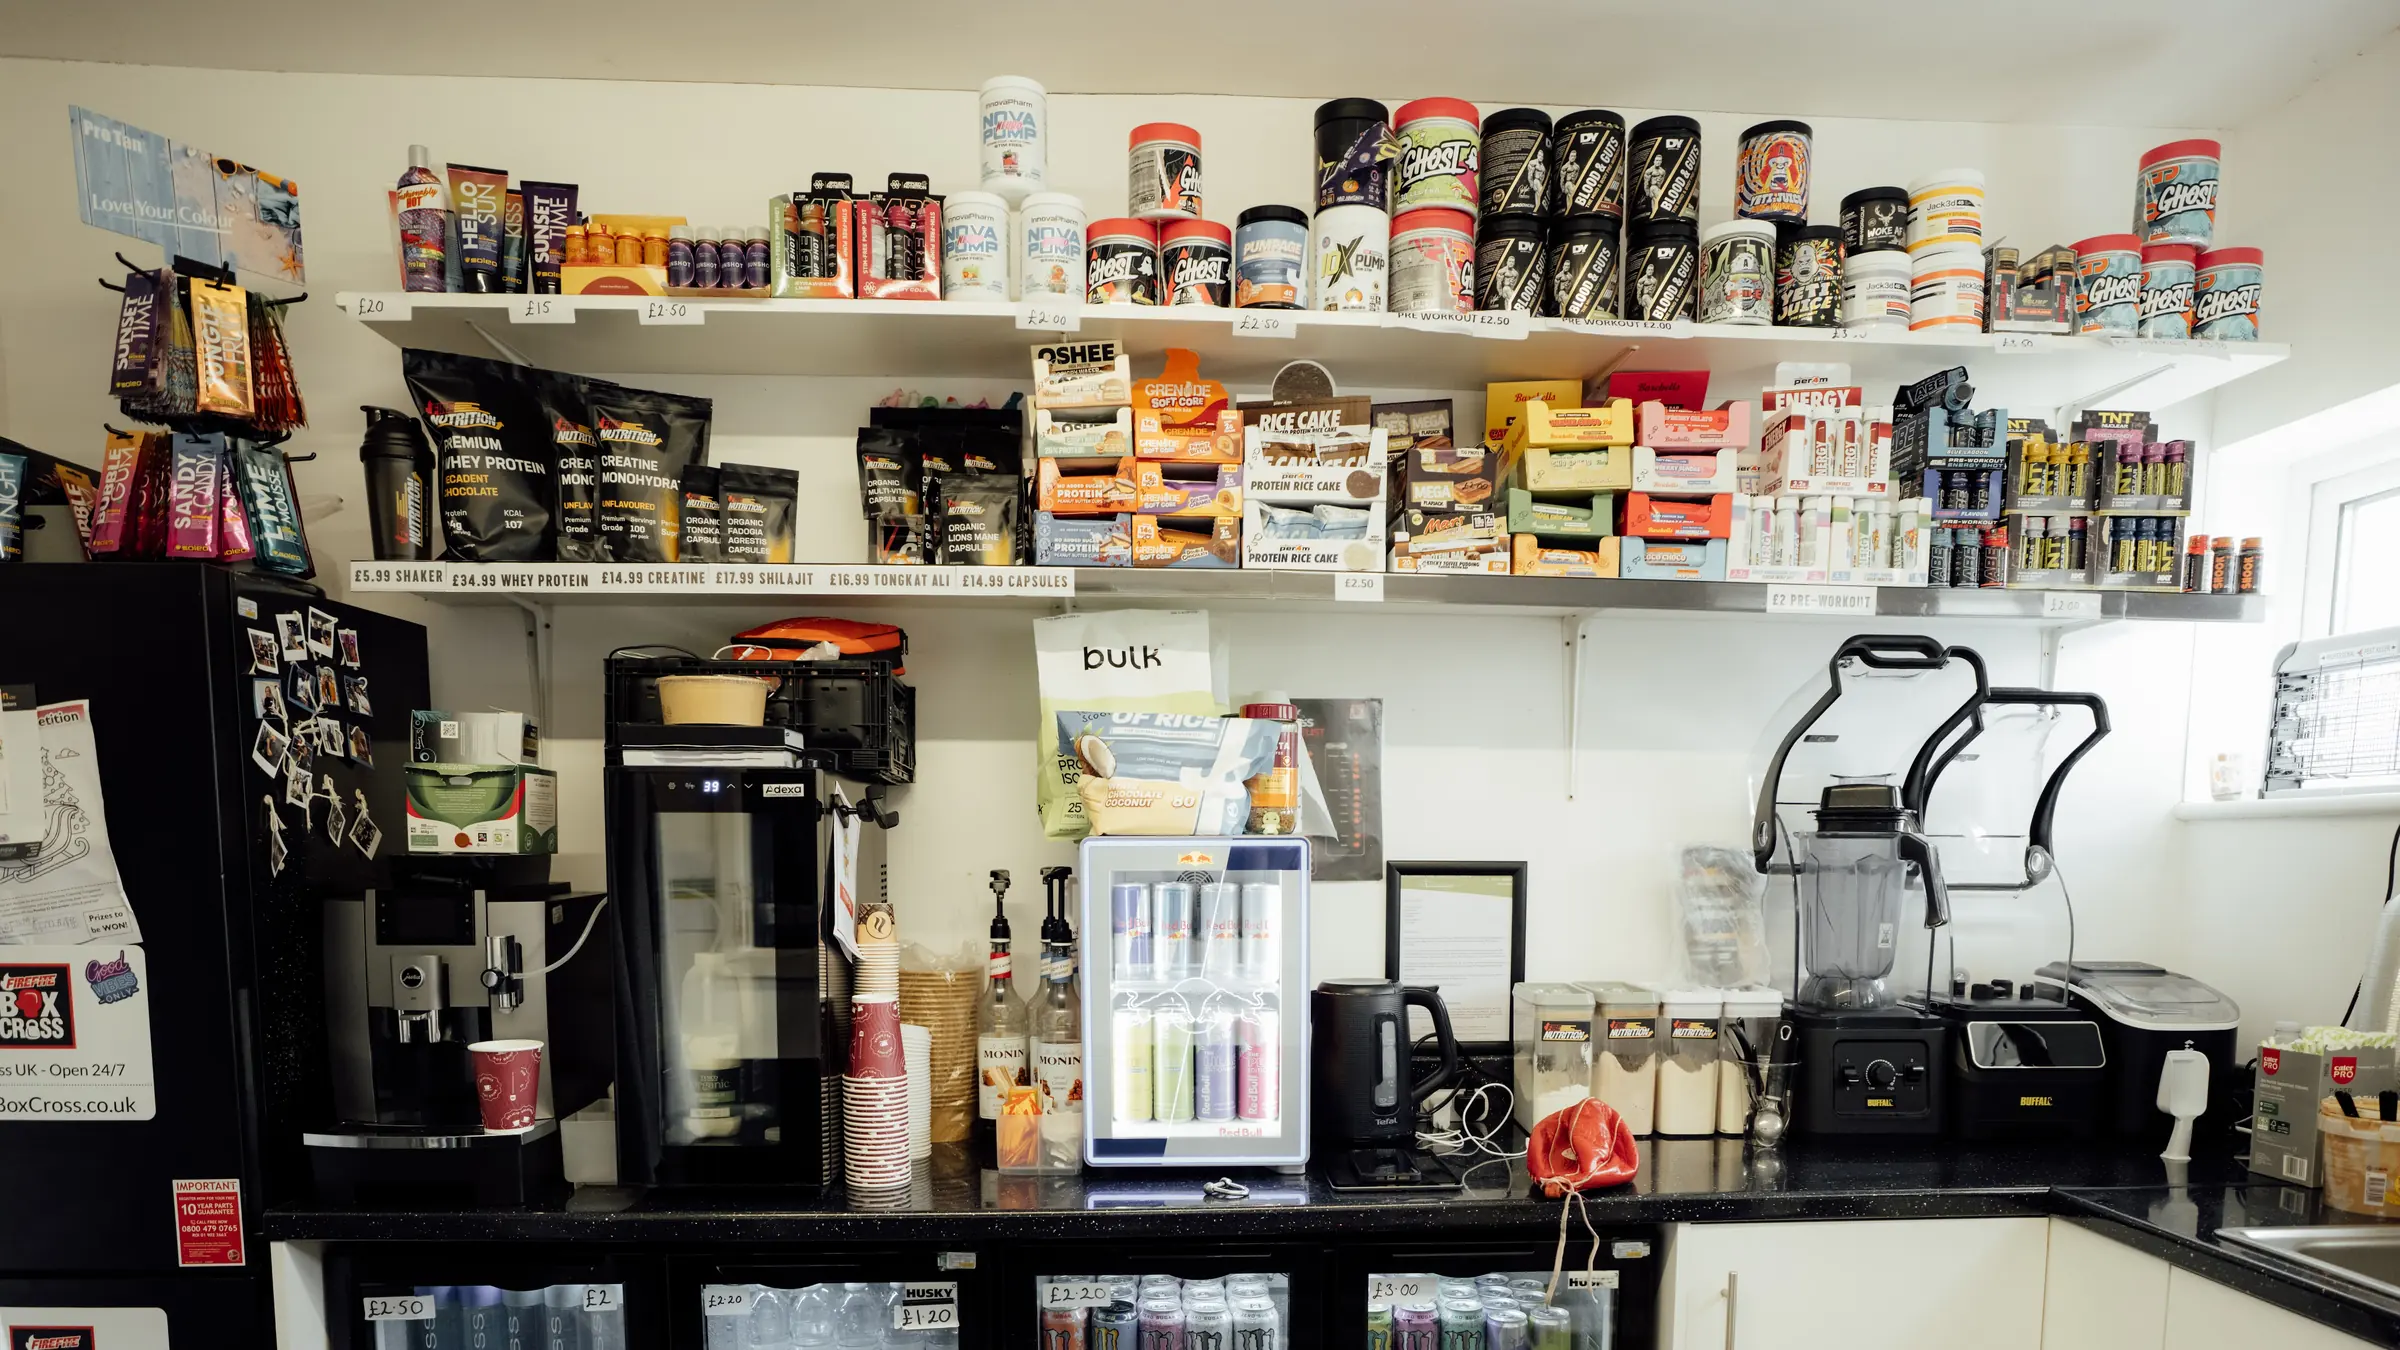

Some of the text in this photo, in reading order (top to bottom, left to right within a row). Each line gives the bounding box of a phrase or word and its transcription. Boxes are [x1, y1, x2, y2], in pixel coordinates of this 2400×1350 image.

[983, 111, 1035, 129] NOVA
[83, 119, 143, 153] Pro Tan
[983, 128, 1037, 144] PUMP
[1402, 139, 1471, 188] GHOST
[406, 197, 421, 208] HOT
[477, 184, 498, 226] SUN
[1926, 200, 1956, 211] Jack3d
[2156, 180, 2217, 220] GHOST
[92, 193, 235, 229] Love Your Colour
[461, 181, 479, 250] HELLO
[549, 197, 568, 238] TIME
[947, 213, 994, 223] InnovaPharm
[505, 202, 524, 238] KISS
[533, 195, 551, 264] SUNSET
[945, 225, 998, 242] NOVA
[1028, 227, 1081, 243] NOVA
[1867, 226, 1892, 238] WOKE
[945, 241, 998, 257] PUMP
[1028, 242, 1081, 257] PUMP
[1243, 238, 1302, 255] PUMPAGE
[1518, 241, 1535, 251] DY
[1572, 244, 1589, 254] DY
[1657, 248, 1676, 258] DY
[1355, 254, 1385, 269] PUMP
[1174, 257, 1228, 292] GHOST
[1568, 247, 1612, 315] BLOOD & GUTS
[1652, 251, 1695, 320] BLOOD & GUTS
[1782, 282, 1829, 303] YETI
[1866, 282, 1893, 290] Jack3d
[359, 299, 384, 315] £20
[526, 300, 551, 316] £15
[1777, 294, 1832, 321] JUICE
[2195, 284, 2262, 328] GHOST
[131, 293, 154, 341] TIME
[1421, 313, 1477, 324] WORKOUT
[1480, 315, 1510, 326] £2.50
[1584, 318, 1641, 329] WORKOUT
[1643, 321, 1672, 331] £2.00
[117, 296, 138, 371] SUNSET
[1037, 343, 1115, 365] OSHEE
[1794, 377, 1828, 386] per4m
[1151, 397, 1204, 408] SOFT CORE
[1776, 389, 1850, 408] ENERGY
[1260, 410, 1341, 431] RICE CAKE
[1413, 415, 1446, 429] MEGA
[2099, 413, 2134, 424] TNT
[444, 435, 503, 452] PREMIUM
[600, 430, 656, 443] NUTRITION
[485, 456, 546, 475] PROTEIN
[601, 455, 659, 471] CREATINE
[111, 447, 136, 502] GUM
[193, 453, 217, 508] CANDY
[867, 479, 900, 487] ORGANIC
[1250, 481, 1341, 491] PROTEIN RICE CAKE
[174, 454, 197, 530] SANDY
[275, 469, 292, 525] MOUSSE
[868, 488, 917, 496] MULTI-VITAMIN
[1414, 485, 1451, 499] MEGA
[249, 464, 284, 542] LIME
[602, 500, 656, 511] UNFLAVOURED
[504, 509, 524, 518] KCAL
[504, 521, 522, 529] 107
[601, 524, 623, 532] Grade
[630, 516, 656, 526] Servings
[727, 518, 763, 527] ORGANIC
[948, 523, 986, 532] ORGANIC
[1424, 516, 1465, 535] Mars
[566, 525, 588, 533] Grade
[630, 525, 646, 533] 100
[728, 527, 763, 536] FADOGIA
[728, 536, 767, 545] AGRESTIS
[948, 533, 999, 542] LIONS MANE
[728, 546, 770, 555] CAPSULES
[1248, 553, 1338, 563] PROTEIN RICE CAKE
[355, 569, 443, 583] £5.99 SHAKER
[452, 574, 589, 587] £34.99 WHEY PROTEIN
[602, 571, 706, 585] £14.99 CREATINE
[716, 572, 814, 586] £17.99 SHILAJIT
[830, 573, 949, 587] £16.99 TONGKAT ALI
[962, 574, 1068, 588] £14.99 CAPSULES
[1345, 578, 1374, 589] £2.50
[1773, 594, 1871, 608] £2 PRE-WORKOUT
[1084, 645, 1162, 670] bulk
[703, 781, 720, 793] 39
[765, 785, 803, 795] Adexa
[1107, 790, 1163, 799] CHOCOLATE
[1068, 803, 1082, 813] 25
[1105, 799, 1154, 807] COCONUT
[1172, 796, 1195, 808] 80
[88, 912, 112, 921] Prizes
[91, 921, 128, 933] be WON!
[87, 950, 130, 982] Good
[6, 974, 57, 989] FIREFITE
[92, 972, 138, 996] VIBES
[0, 1018, 64, 1040] CROSS
[1543, 1031, 1584, 1040] NUTRITION
[1610, 1028, 1649, 1037] NUTRITION
[1672, 1028, 1714, 1037] NUTRITION
[984, 1049, 1024, 1059] MONIN
[1039, 1056, 1081, 1065] MONIN
[16, 1064, 37, 1076] UK
[50, 1064, 88, 1079] Open
[92, 1064, 126, 1077] 24/7
[1375, 1118, 1397, 1126] Tefal
[176, 1182, 237, 1190] IMPORTANT
[181, 1203, 197, 1215] 10
[586, 1289, 612, 1306] £2
[906, 1288, 952, 1298] HUSKY
[1050, 1287, 1106, 1303] £2.20
[1373, 1283, 1418, 1298] £3.00
[903, 1309, 951, 1327] £1.20
